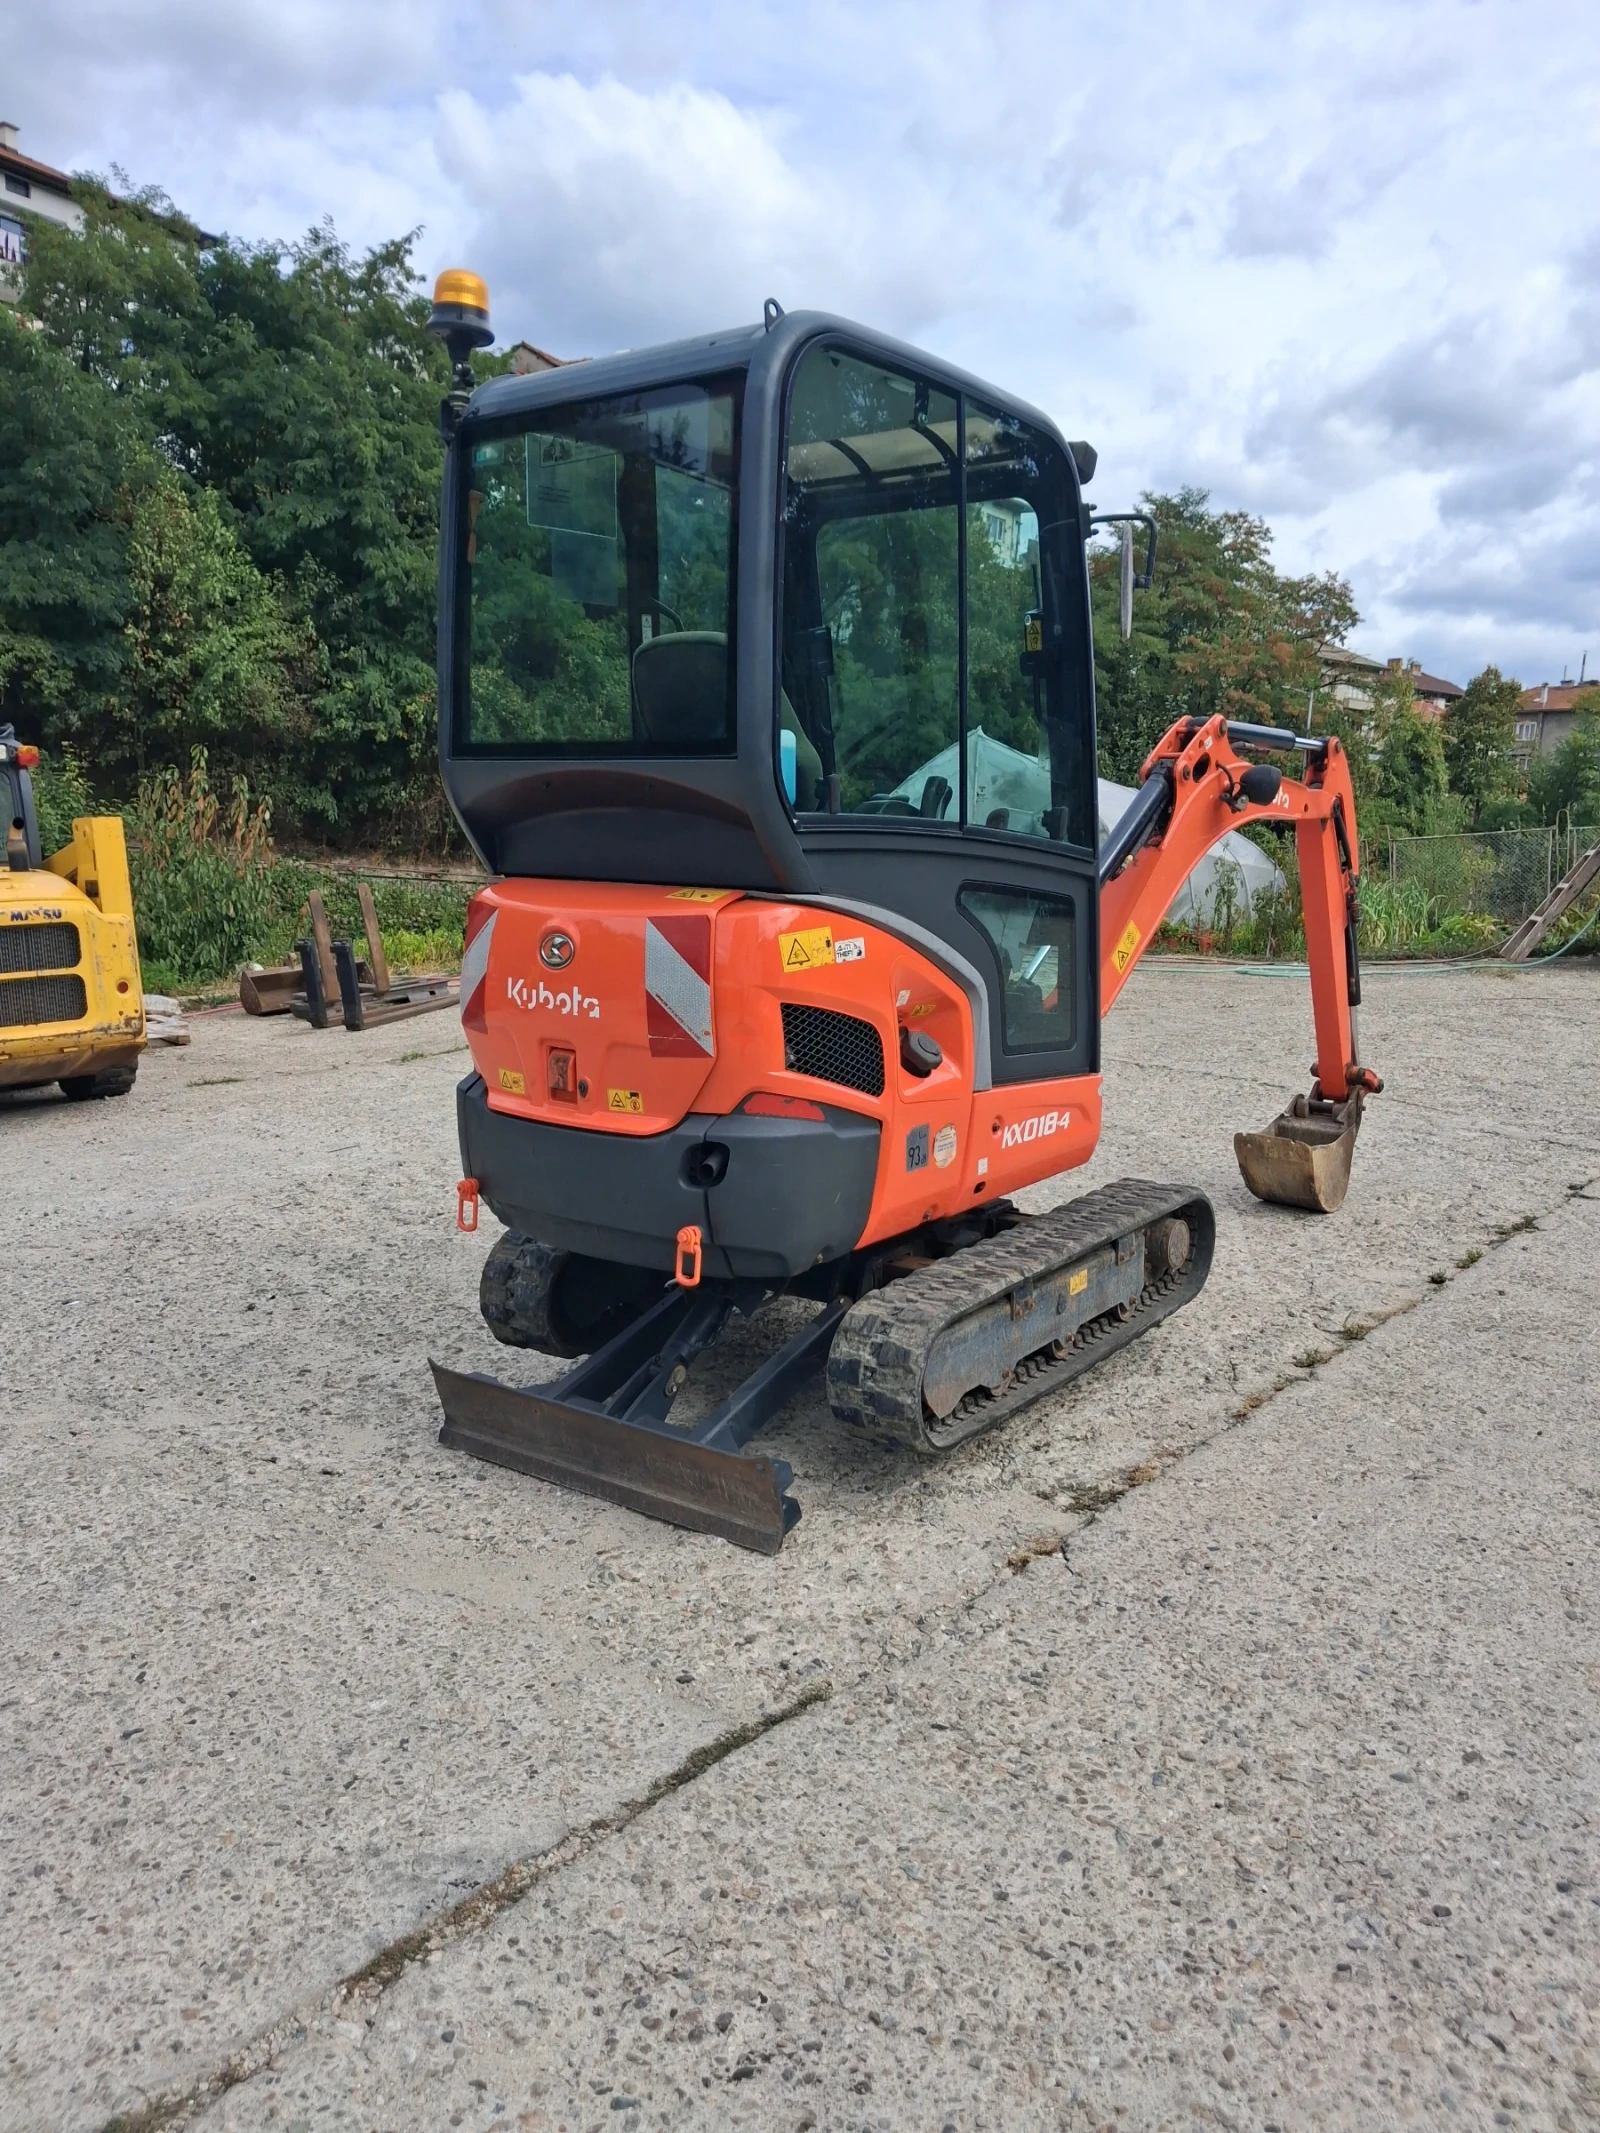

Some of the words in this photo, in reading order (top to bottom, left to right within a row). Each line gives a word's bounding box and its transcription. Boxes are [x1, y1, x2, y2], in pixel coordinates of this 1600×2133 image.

[507, 976, 600, 1019] Kubota
[1001, 1111, 1070, 1149] KX018-4
[908, 1145, 921, 1168] 93
